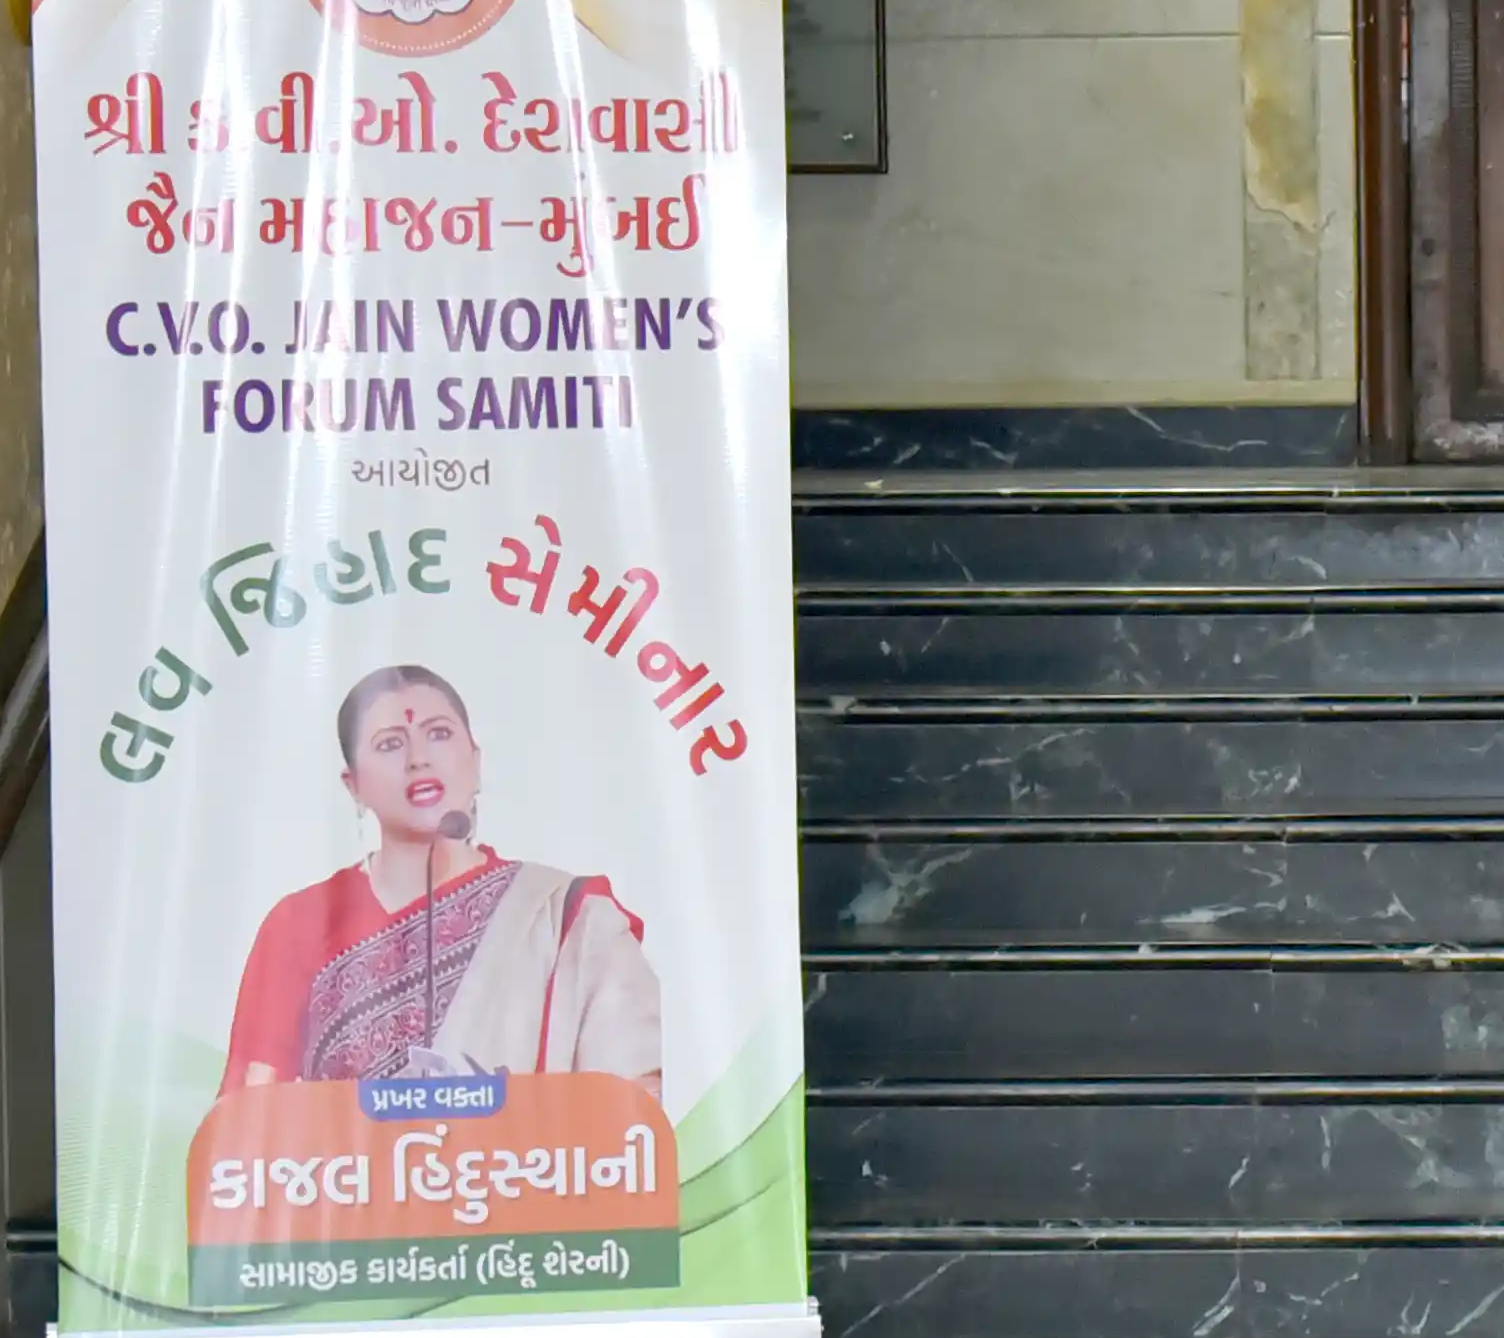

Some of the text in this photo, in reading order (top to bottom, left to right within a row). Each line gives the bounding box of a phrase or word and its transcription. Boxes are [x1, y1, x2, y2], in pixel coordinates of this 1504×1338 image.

[84, 71, 167, 156] શ્રી
[481, 71, 740, 155] દેરાવાસી
[126, 171, 706, 279] જૈન મહાજન-મુંબઈ
[104, 301, 266, 358] C.V.O.
[284, 298, 416, 354] JAIN
[202, 375, 634, 435] FORUM SAMITI
[351, 447, 491, 492] આયોજીત
[98, 512, 751, 785] લવ જિહાદ સેમીનાર
[372, 1084, 495, 1112] પ્રખર વક્તા
[208, 1123, 657, 1224] કાજલ હિંદુસ્થાની
[239, 1258, 359, 1291] સામાજીક
[366, 1243, 469, 1284] કાર્યકર્તા
[542, 1239, 632, 1280] શેરની)
